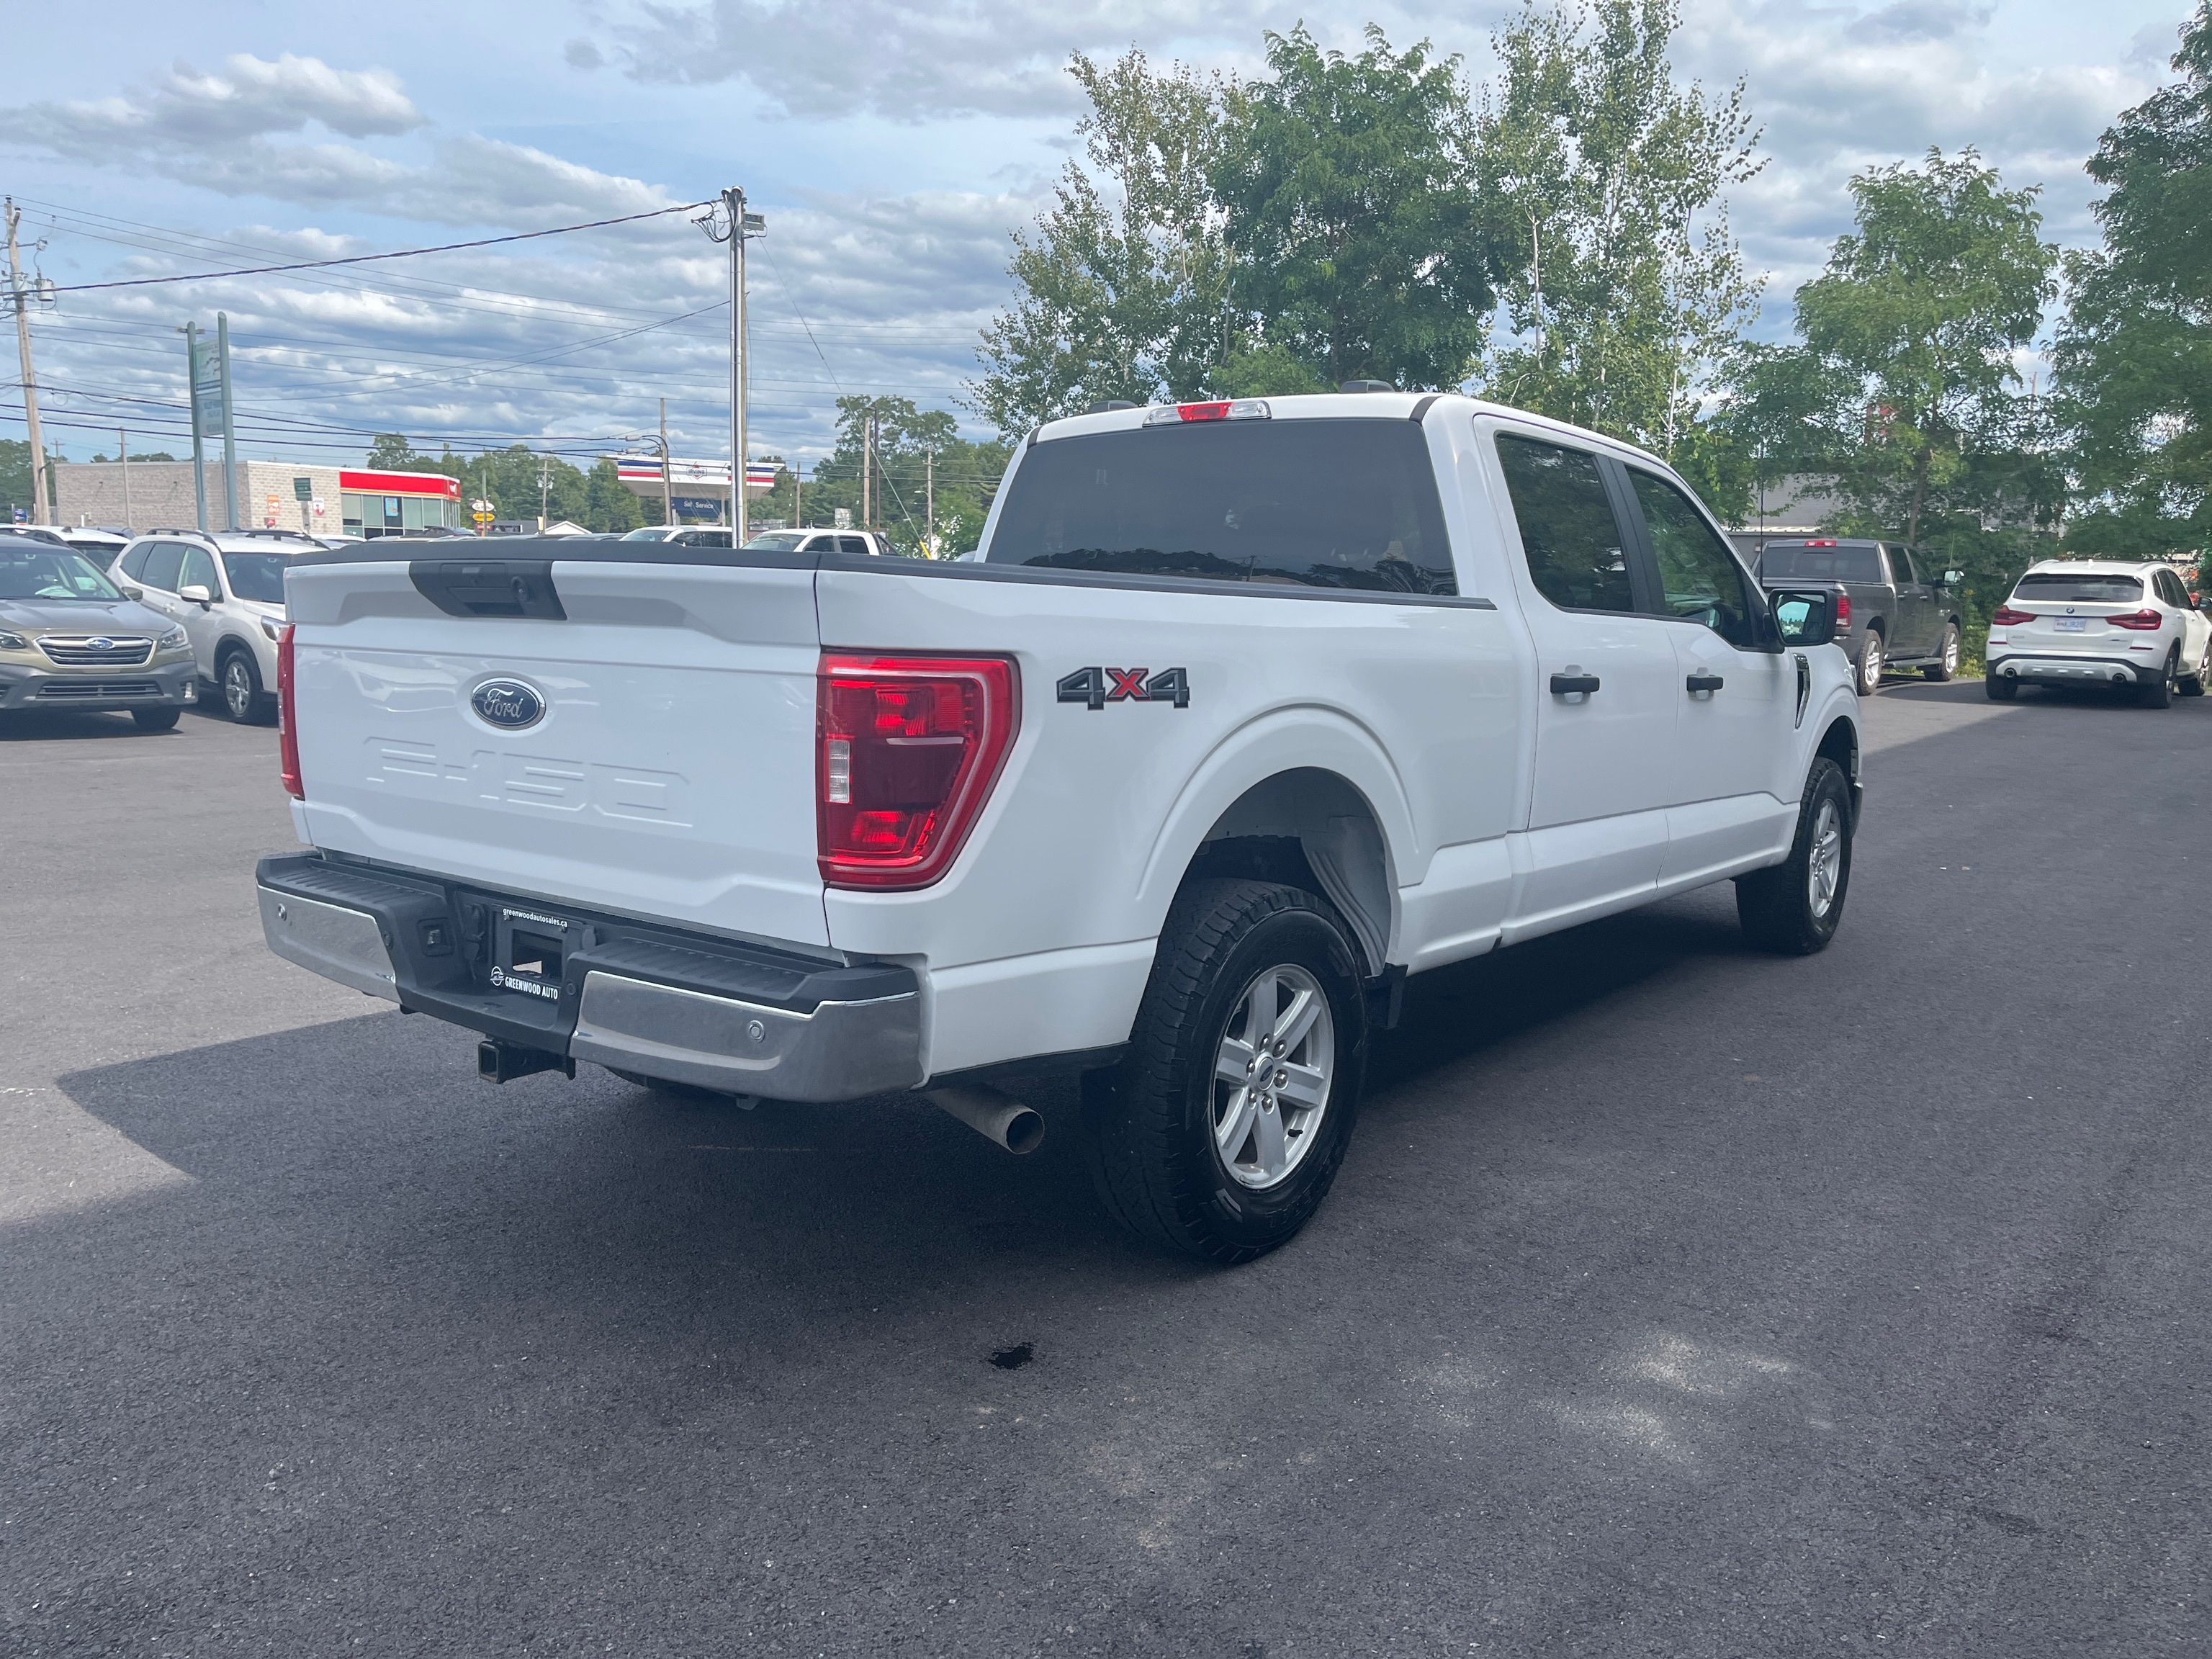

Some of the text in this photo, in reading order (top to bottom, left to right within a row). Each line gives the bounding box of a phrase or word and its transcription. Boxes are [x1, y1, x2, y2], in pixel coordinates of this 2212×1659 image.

[695, 500, 714, 509] Service
[483, 688, 523, 718] Ford
[364, 737, 693, 827] F-150
[503, 908, 568, 927] greenwoodautosales.ca
[505, 976, 558, 999] GREENWOOD AUTO
